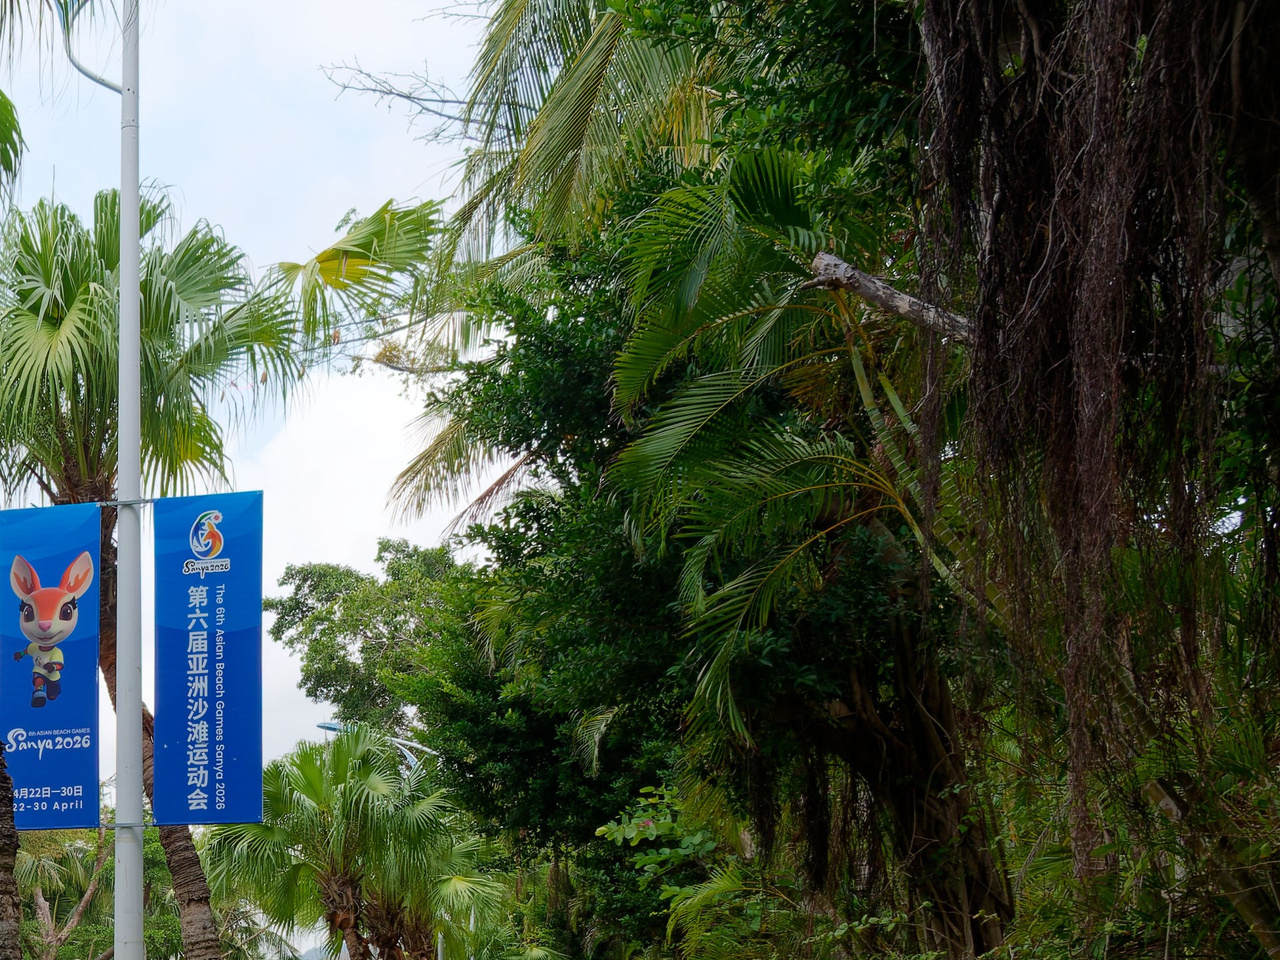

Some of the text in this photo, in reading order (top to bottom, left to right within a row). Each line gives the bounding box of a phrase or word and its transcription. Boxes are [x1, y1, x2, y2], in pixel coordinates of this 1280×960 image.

[183, 560, 209, 578] Sanya
[210, 563, 229, 571] 2026
[186, 585, 209, 810] 第六届亚洲沙滩运动会
[213, 583, 225, 810] The 6th Asian Beach Games Sanya 2026
[5, 728, 91, 760] Sanya 2026
[52, 800, 83, 812] April
